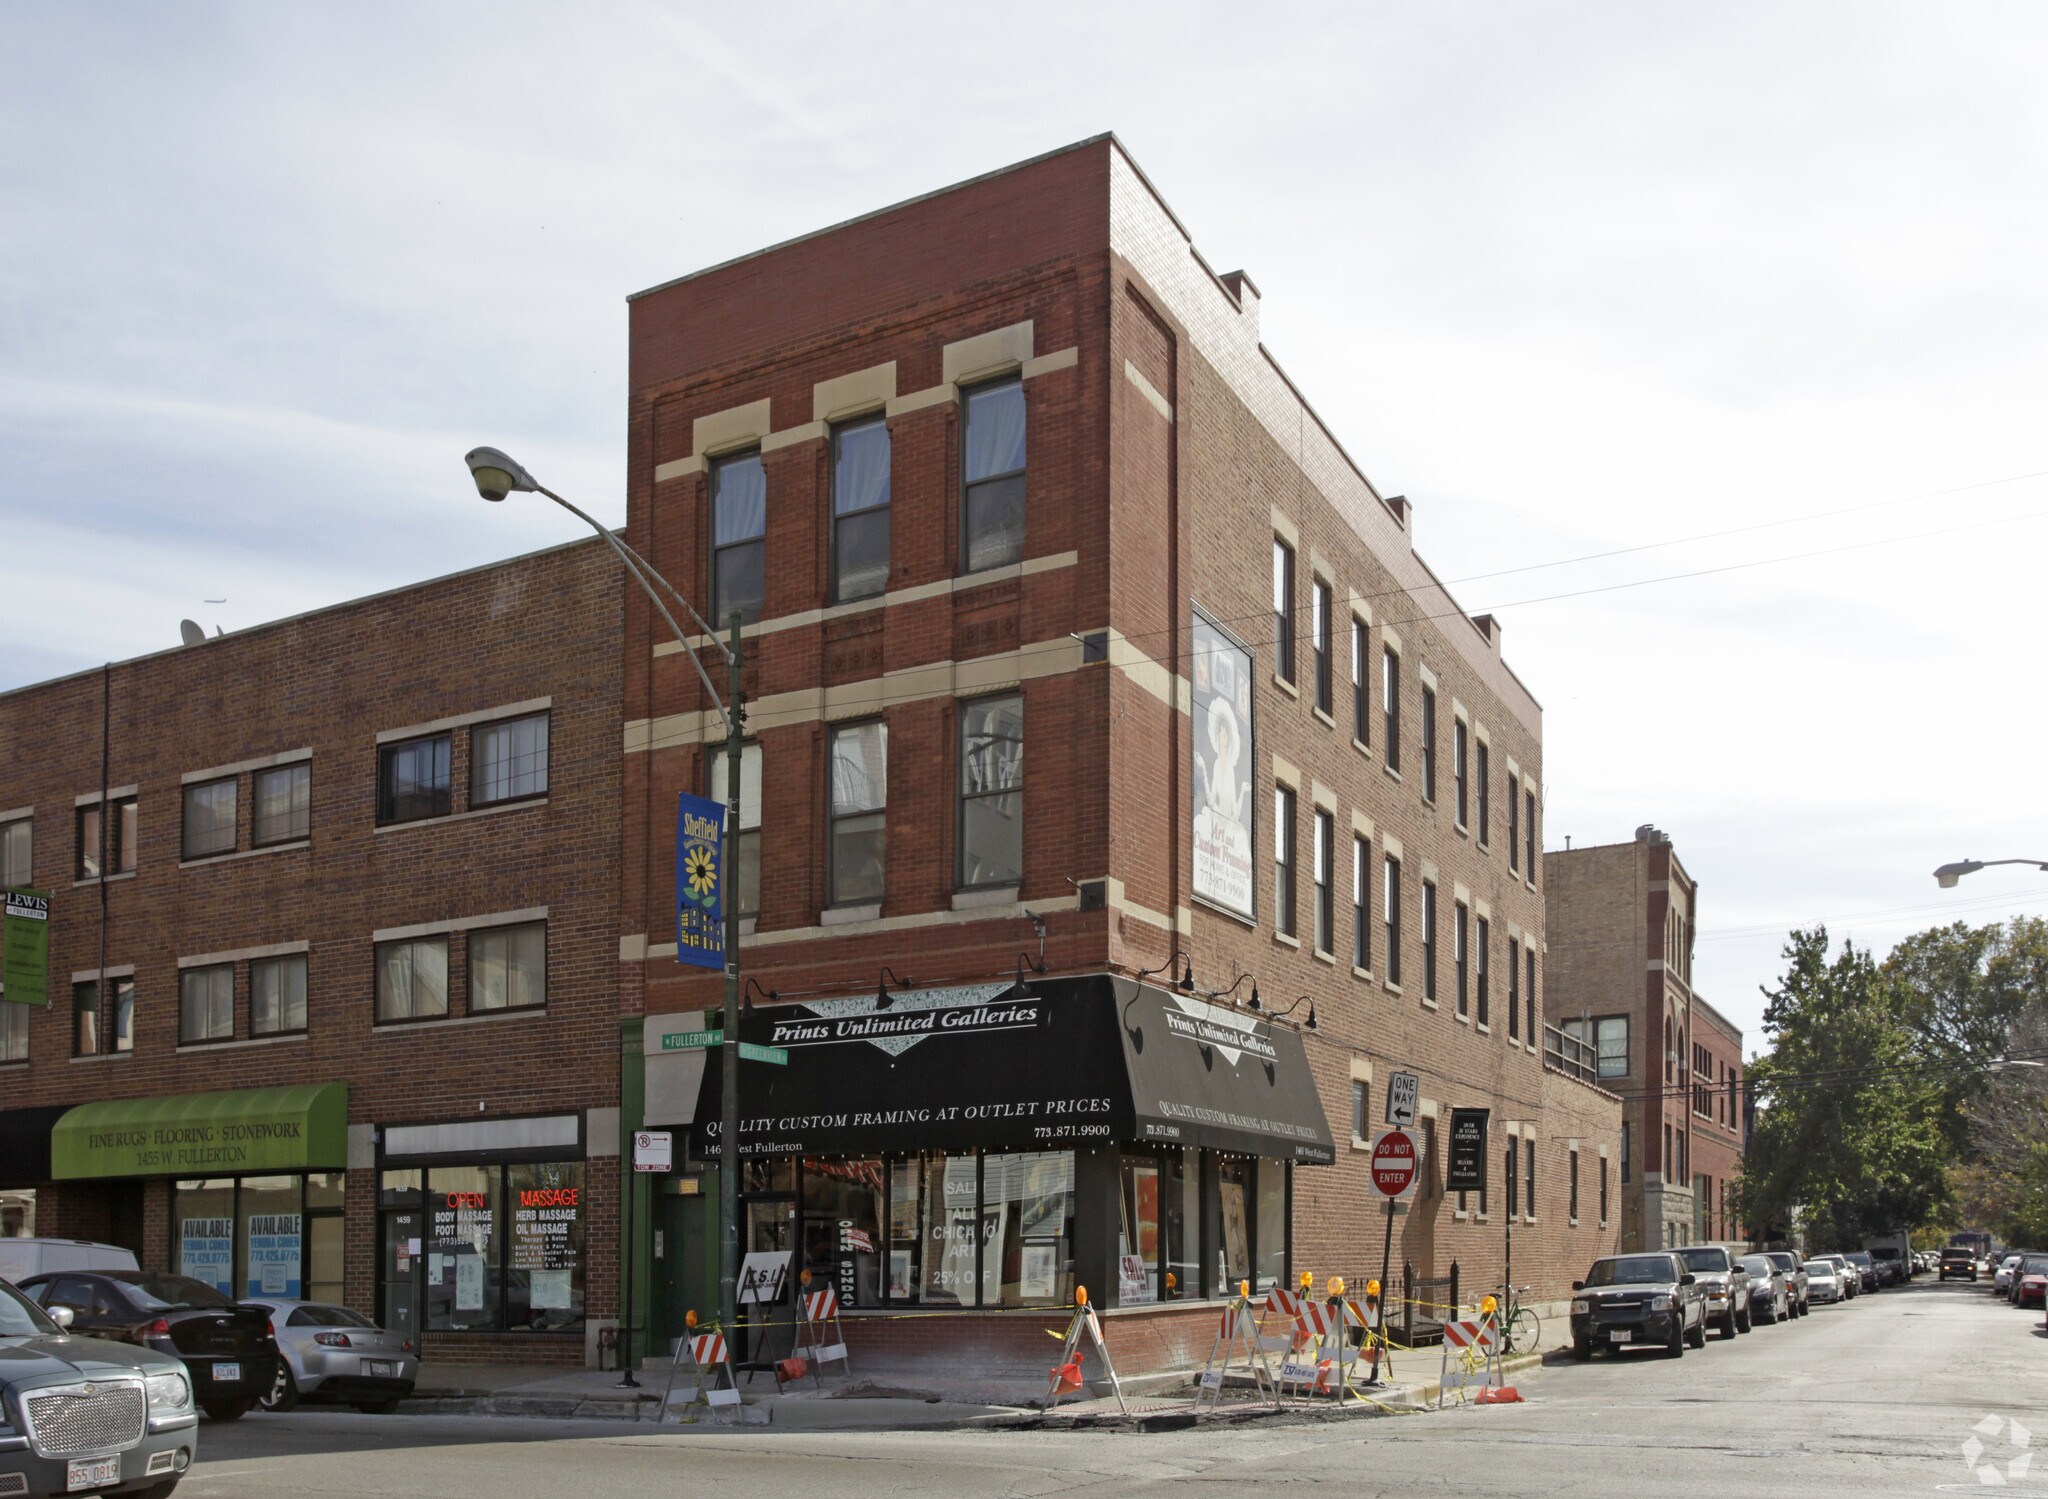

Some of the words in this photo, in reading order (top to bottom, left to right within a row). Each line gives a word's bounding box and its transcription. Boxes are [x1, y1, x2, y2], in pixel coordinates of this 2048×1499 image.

[684, 812, 718, 842] Sheffield
[1213, 822, 1225, 842] Art
[6, 892, 48, 910] LEWIS
[771, 1024, 829, 1042] Prints
[836, 1012, 937, 1037] Unlimited
[941, 1007, 1038, 1029] Galleries
[671, 1033, 713, 1047] FULLERTON
[1166, 1013, 1196, 1034] Prints
[1195, 1021, 1239, 1046] Unlimited
[1240, 1034, 1276, 1056] Galleries
[1395, 1077, 1415, 1092] ONE
[1394, 1091, 1414, 1105] WAY
[706, 1118, 775, 1137] QULITY
[779, 1114, 848, 1131] CUSTOM
[853, 1109, 930, 1126] FRAMING
[936, 1106, 959, 1121] AT
[964, 1102, 1039, 1119] OUTLET
[1045, 1098, 1111, 1115] PRICES
[1159, 1100, 1195, 1119] QUALITY
[1195, 1107, 1228, 1124] CUSTOM
[1228, 1113, 1260, 1130] FRAMING
[1270, 1120, 1295, 1136] OUTLET
[1296, 1125, 1318, 1140] PRICES
[89, 1132, 114, 1149] FINE
[116, 1131, 147, 1146] RUGS
[154, 1127, 214, 1144] FLOORING
[222, 1122, 300, 1141] STONEWORK
[1034, 1125, 1111, 1138] 773.871.9900
[137, 1151, 159, 1166] 1455
[178, 1147, 246, 1164] FULLERTON
[704, 1145, 722, 1155] 146
[737, 1144, 752, 1154] est
[755, 1142, 803, 1153] Fullerton
[1379, 1144, 1390, 1155] DO
[1394, 1144, 1410, 1155] NOT
[1380, 1172, 1405, 1184] ENTER
[447, 1192, 485, 1208] OPEN
[520, 1188, 578, 1207] MASSAGE
[396, 1216, 411, 1224] 1459
[435, 1211, 455, 1223] BODY
[457, 1210, 493, 1221] MASSAGE
[516, 1210, 537, 1221] HERB
[539, 1209, 577, 1220] MASSAGE
[184, 1220, 231, 1238] AVAILABLE
[250, 1216, 300, 1235] AVAILABLE
[435, 1225, 455, 1236] FOOT
[457, 1224, 492, 1235] MASSAGE
[516, 1223, 528, 1235] OIL
[531, 1223, 568, 1234] MASSAGE
[932, 1225, 996, 1240] CHICAO
[838, 1220, 854, 1252] OPEN
[949, 1245, 976, 1257] ART
[840, 1260, 855, 1306] SUNDAY
[933, 1270, 960, 1285] 25%
[963, 1270, 991, 1284] OF
[69, 1468, 88, 1485] 855
[93, 1463, 119, 1481] 0819
